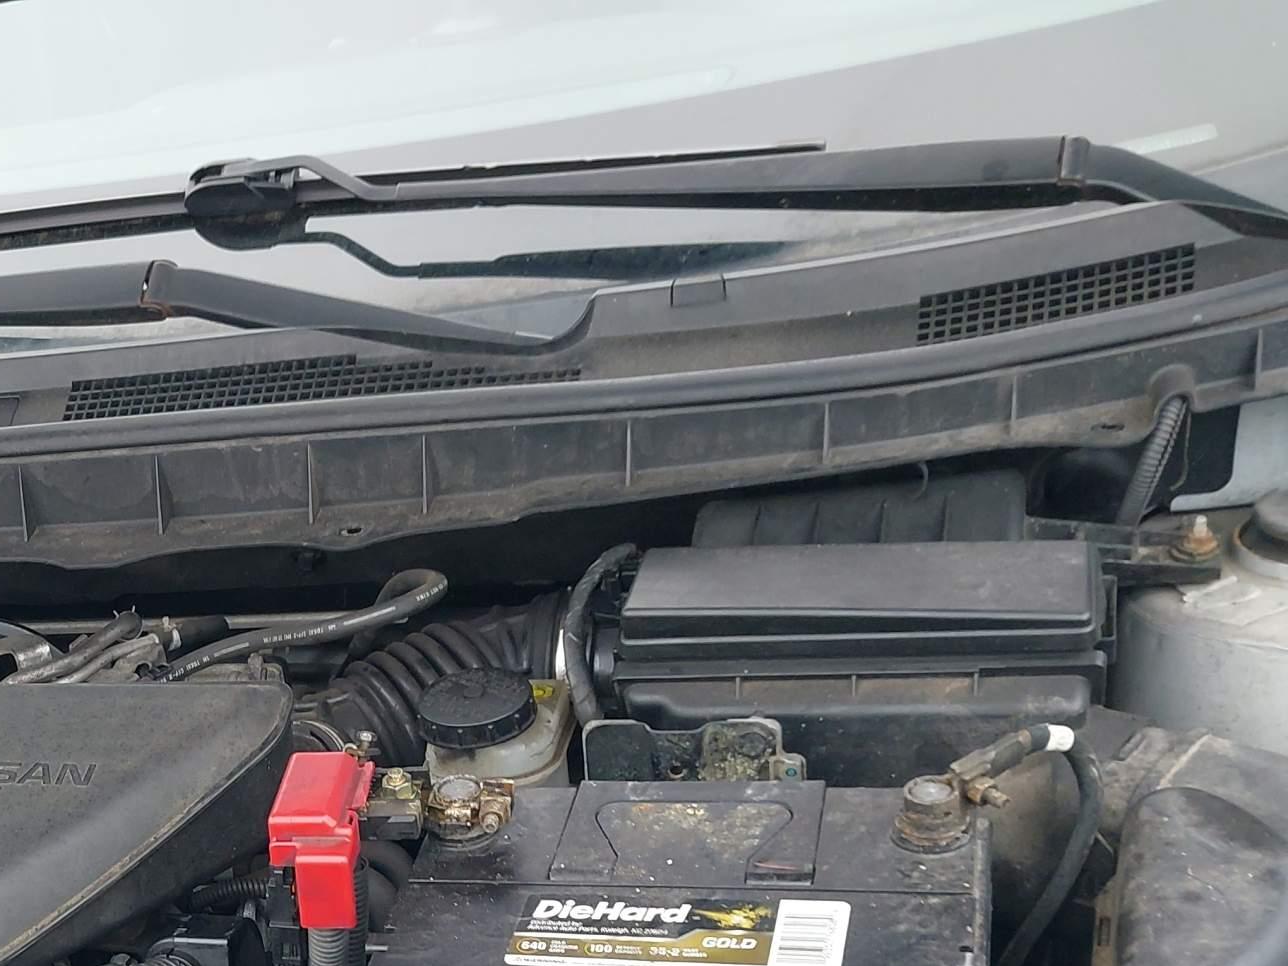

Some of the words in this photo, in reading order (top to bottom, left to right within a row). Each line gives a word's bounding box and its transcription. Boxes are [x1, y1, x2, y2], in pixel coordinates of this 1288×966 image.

[532, 899, 693, 923] DieHard
[521, 940, 547, 951] 640
[590, 943, 613, 953] 100
[701, 936, 757, 950] GOLD
